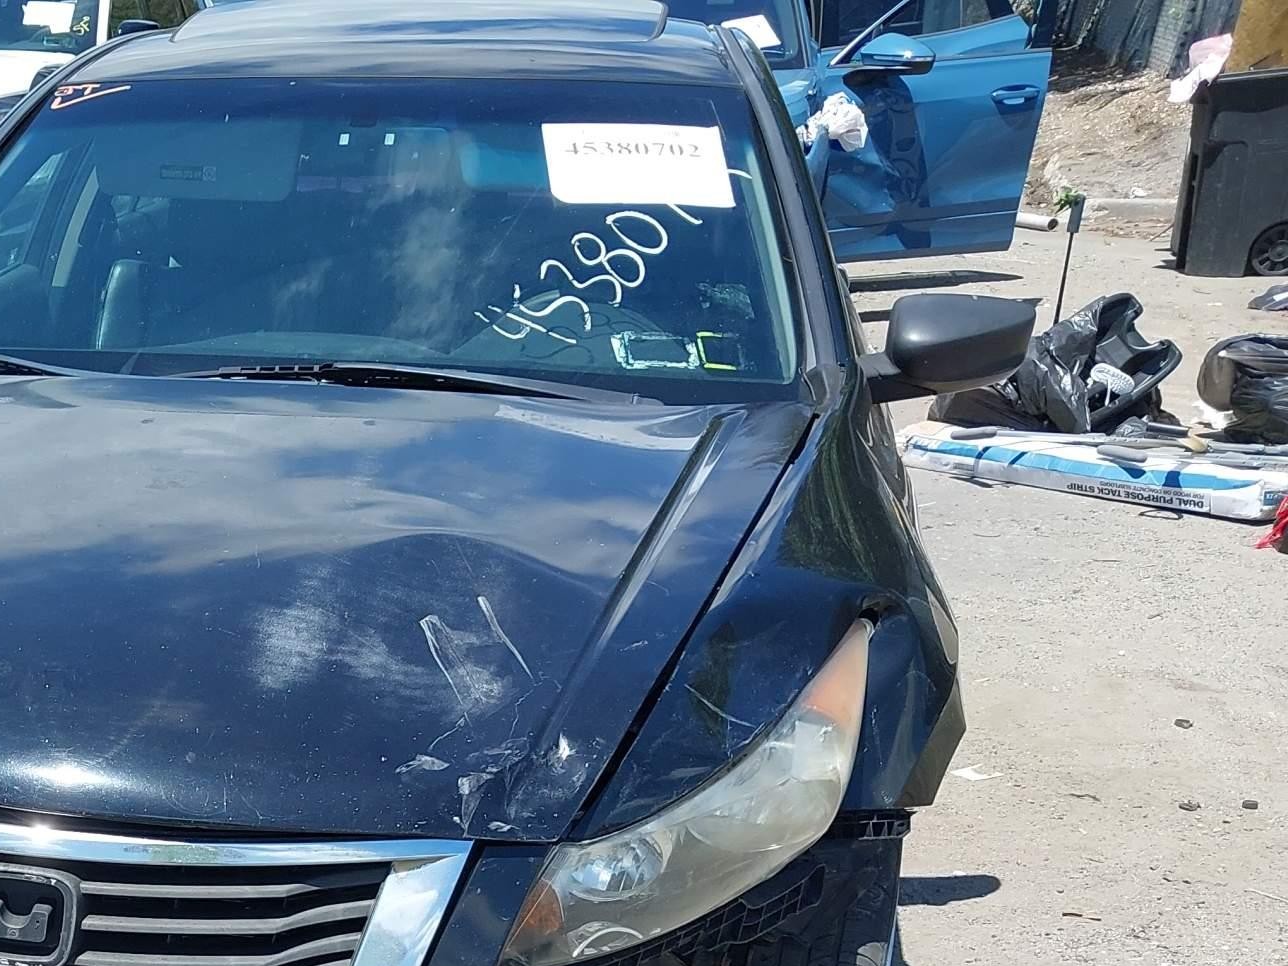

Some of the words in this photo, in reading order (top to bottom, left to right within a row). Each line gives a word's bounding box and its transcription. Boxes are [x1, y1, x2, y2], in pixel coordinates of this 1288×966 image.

[565, 141, 701, 158] 45380702
[1066, 482, 1095, 493] STRIP
[1097, 486, 1122, 497] TACK
[1124, 491, 1174, 505] PURPOSE
[1177, 498, 1204, 508] DUAL
